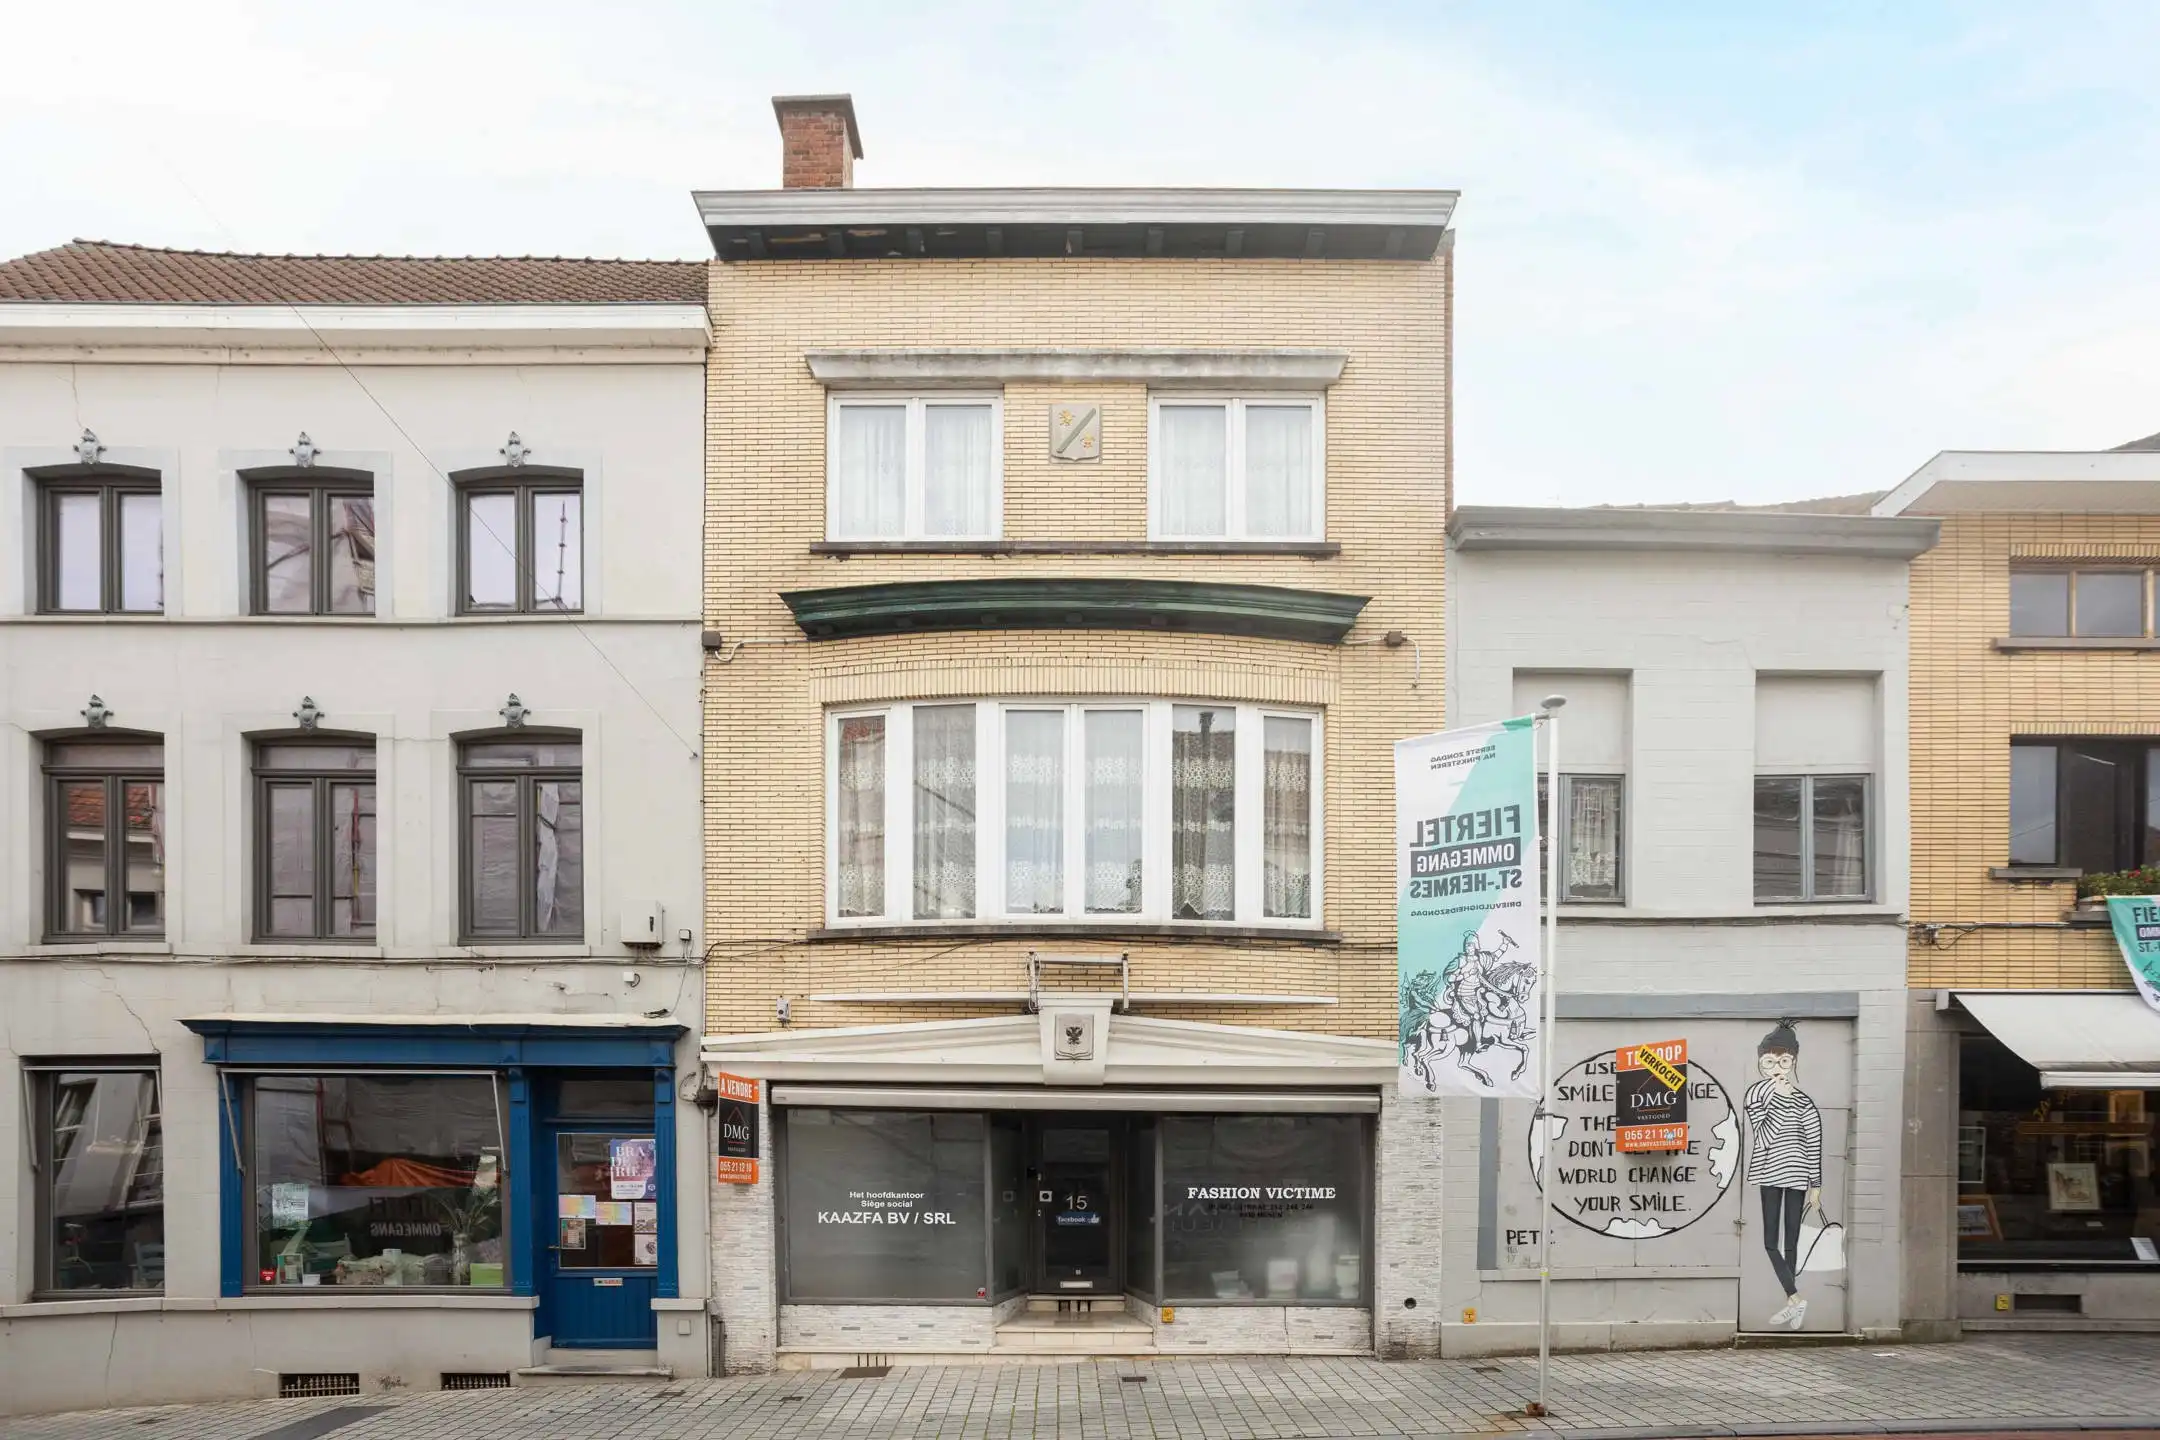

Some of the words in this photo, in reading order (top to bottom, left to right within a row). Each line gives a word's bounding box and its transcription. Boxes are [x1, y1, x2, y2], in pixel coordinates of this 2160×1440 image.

[2132, 906, 2160, 923] FIE
[1652, 1044, 1683, 1062] OOP
[1639, 1048, 1683, 1087] VERKOCHT
[727, 1079, 753, 1099] VENDRE
[1630, 1090, 1678, 1109] DMG
[723, 1123, 750, 1141] DMG
[1580, 1115, 1617, 1132] THE
[1624, 1129, 1643, 1141] 055
[1645, 1129, 1656, 1140] 21
[1568, 1139, 1615, 1158] DON'T
[1558, 1167, 1617, 1185] WORLD
[1628, 1166, 1697, 1184] CHANGE
[849, 1191, 864, 1199] Het
[866, 1191, 925, 1199] hoofdkantoor
[1187, 1187, 1261, 1200] FASHION
[1264, 1187, 1337, 1200] VICTIME
[860, 1200, 885, 1209] Siège
[886, 1200, 913, 1208] social
[1066, 1195, 1088, 1210] 15
[1573, 1195, 1621, 1216] YOUR
[817, 1211, 883, 1224] KAAZFA
[887, 1212, 910, 1224] BV
[923, 1212, 956, 1225] SRL
[1058, 1215, 1086, 1224] facebook
